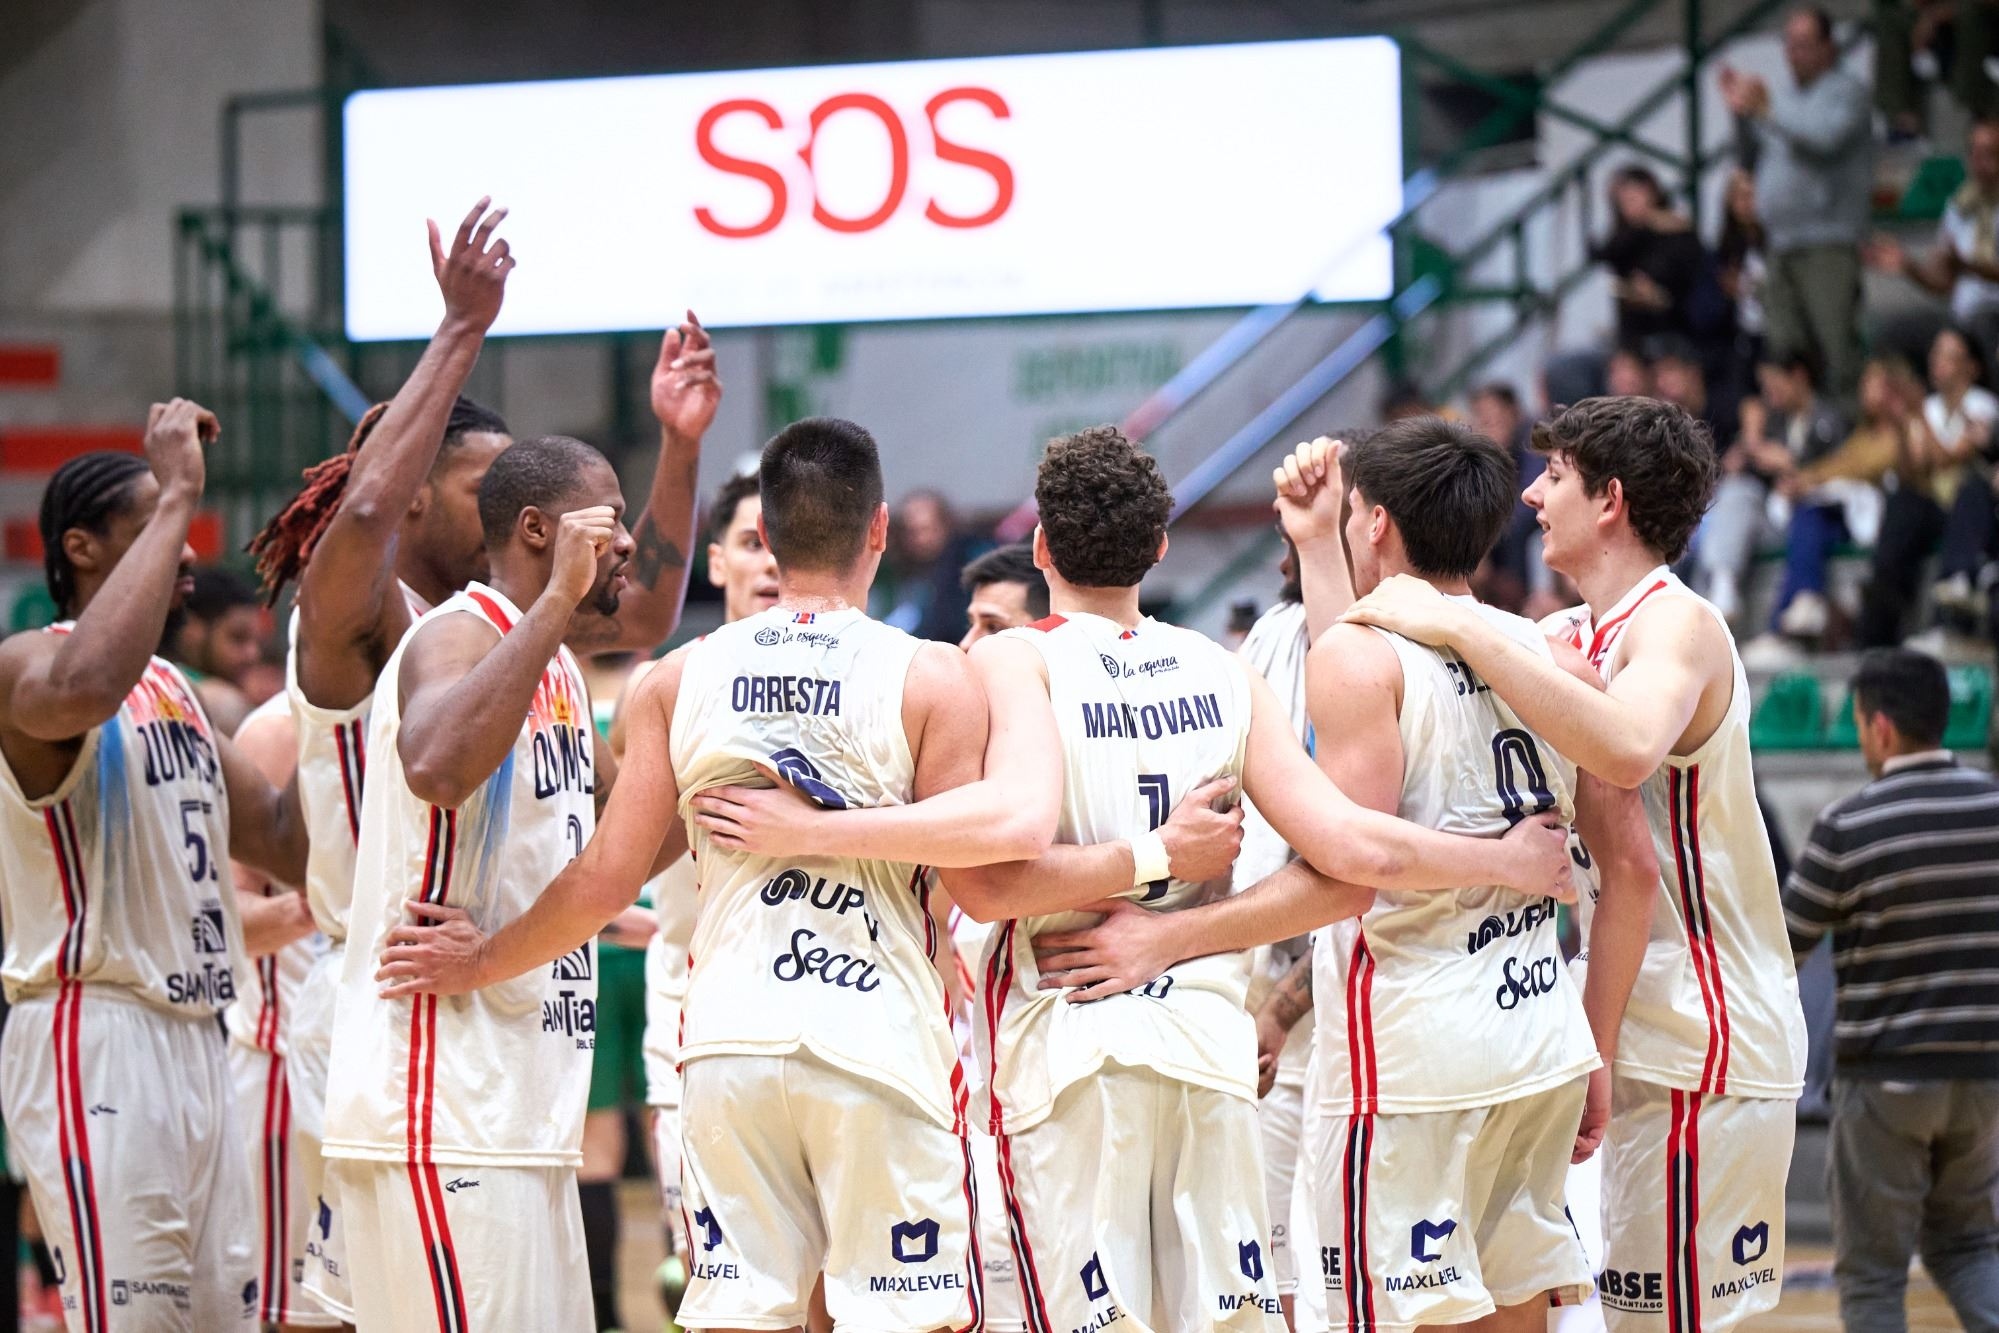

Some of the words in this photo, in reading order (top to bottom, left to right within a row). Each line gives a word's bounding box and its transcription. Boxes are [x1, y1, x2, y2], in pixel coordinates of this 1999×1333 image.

[693, 86, 1014, 239] SOS
[731, 675, 841, 717] ORRESTA
[1081, 693, 1224, 741] MANOVANI
[870, 1273, 964, 1292] MAXLEVEL
[1619, 1299, 1663, 1309] SANTIAGO
